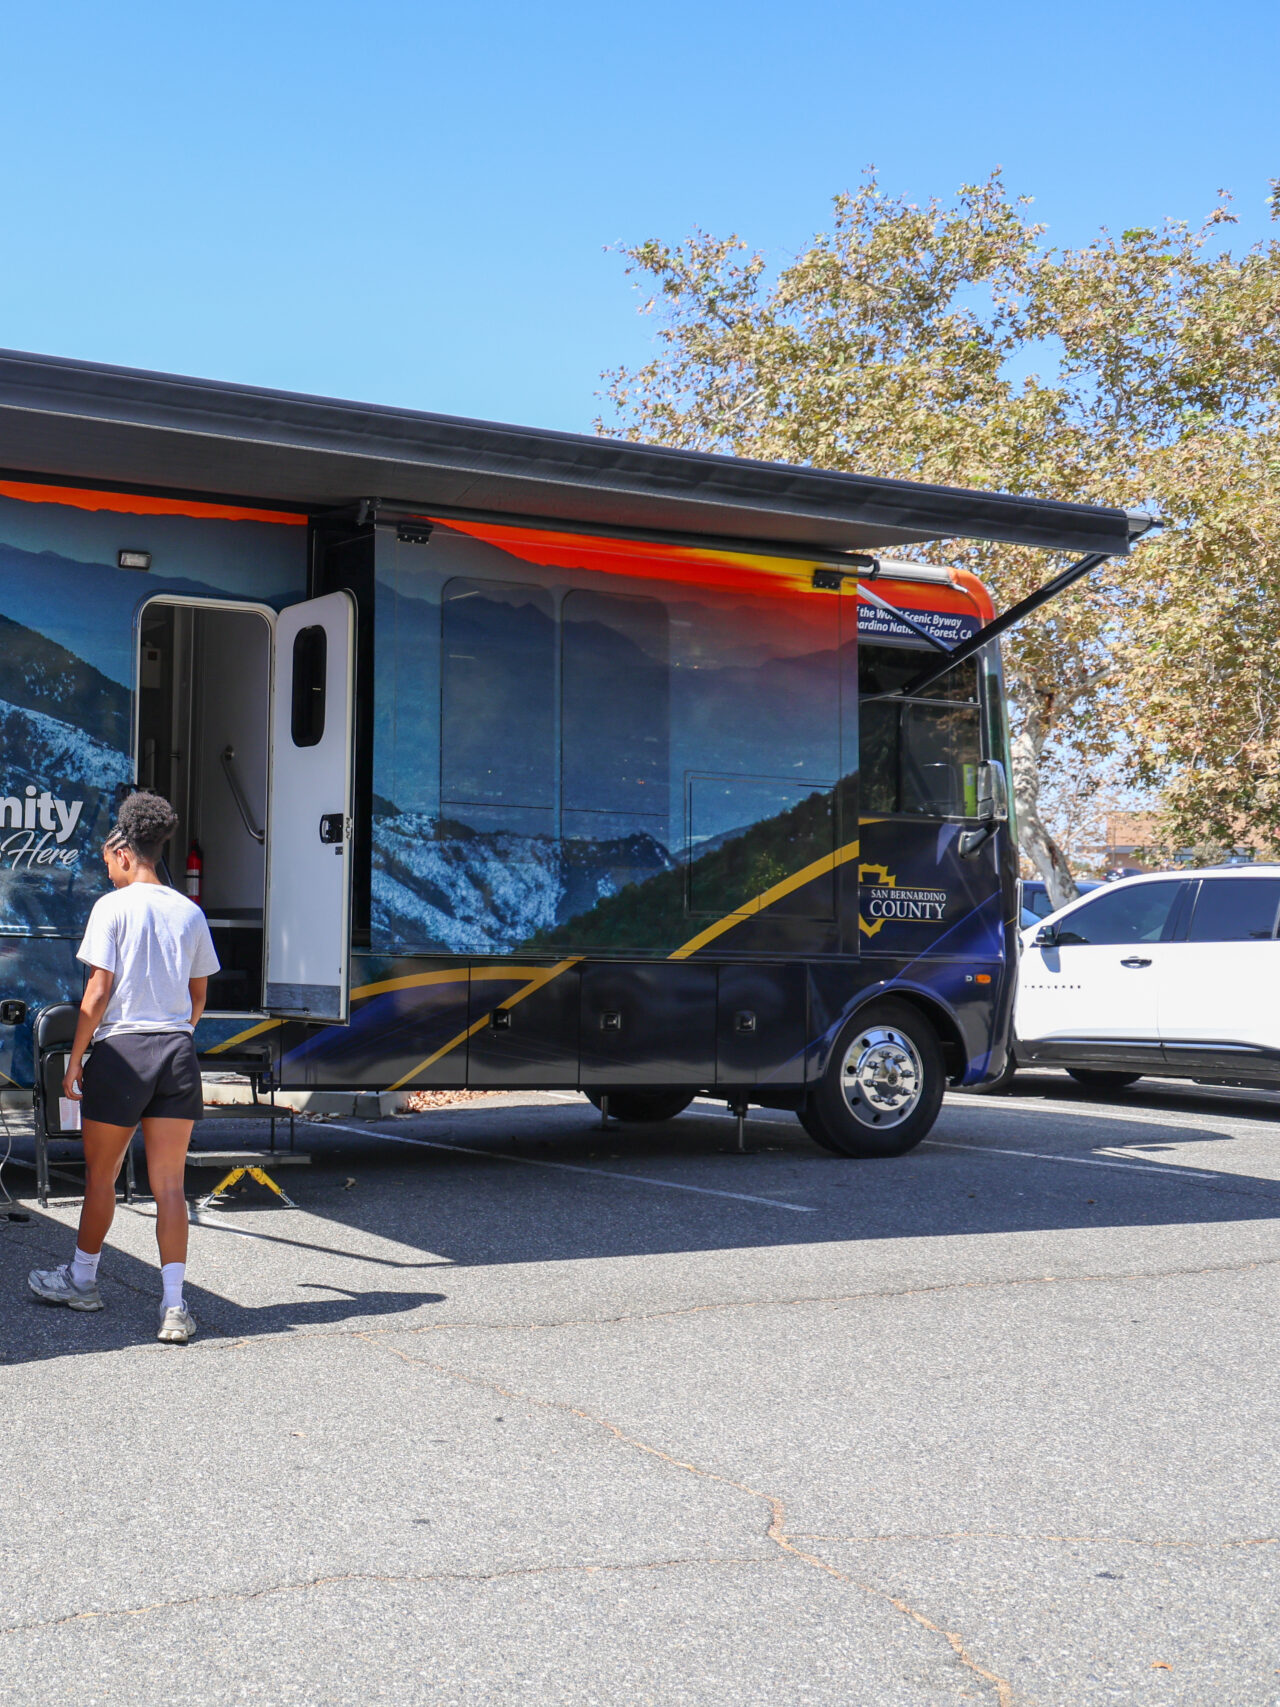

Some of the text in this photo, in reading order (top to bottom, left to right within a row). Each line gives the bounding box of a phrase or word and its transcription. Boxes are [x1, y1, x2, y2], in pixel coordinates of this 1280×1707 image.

[859, 607, 875, 618] the
[905, 611, 932, 624] Scenic
[933, 614, 962, 629] Byway
[929, 627, 958, 640] Forest,
[959, 630, 972, 640] CA
[1, 830, 79, 871] Here
[871, 889, 947, 902] SAN BERNARDINO
[869, 899, 947, 919] COUNTY
